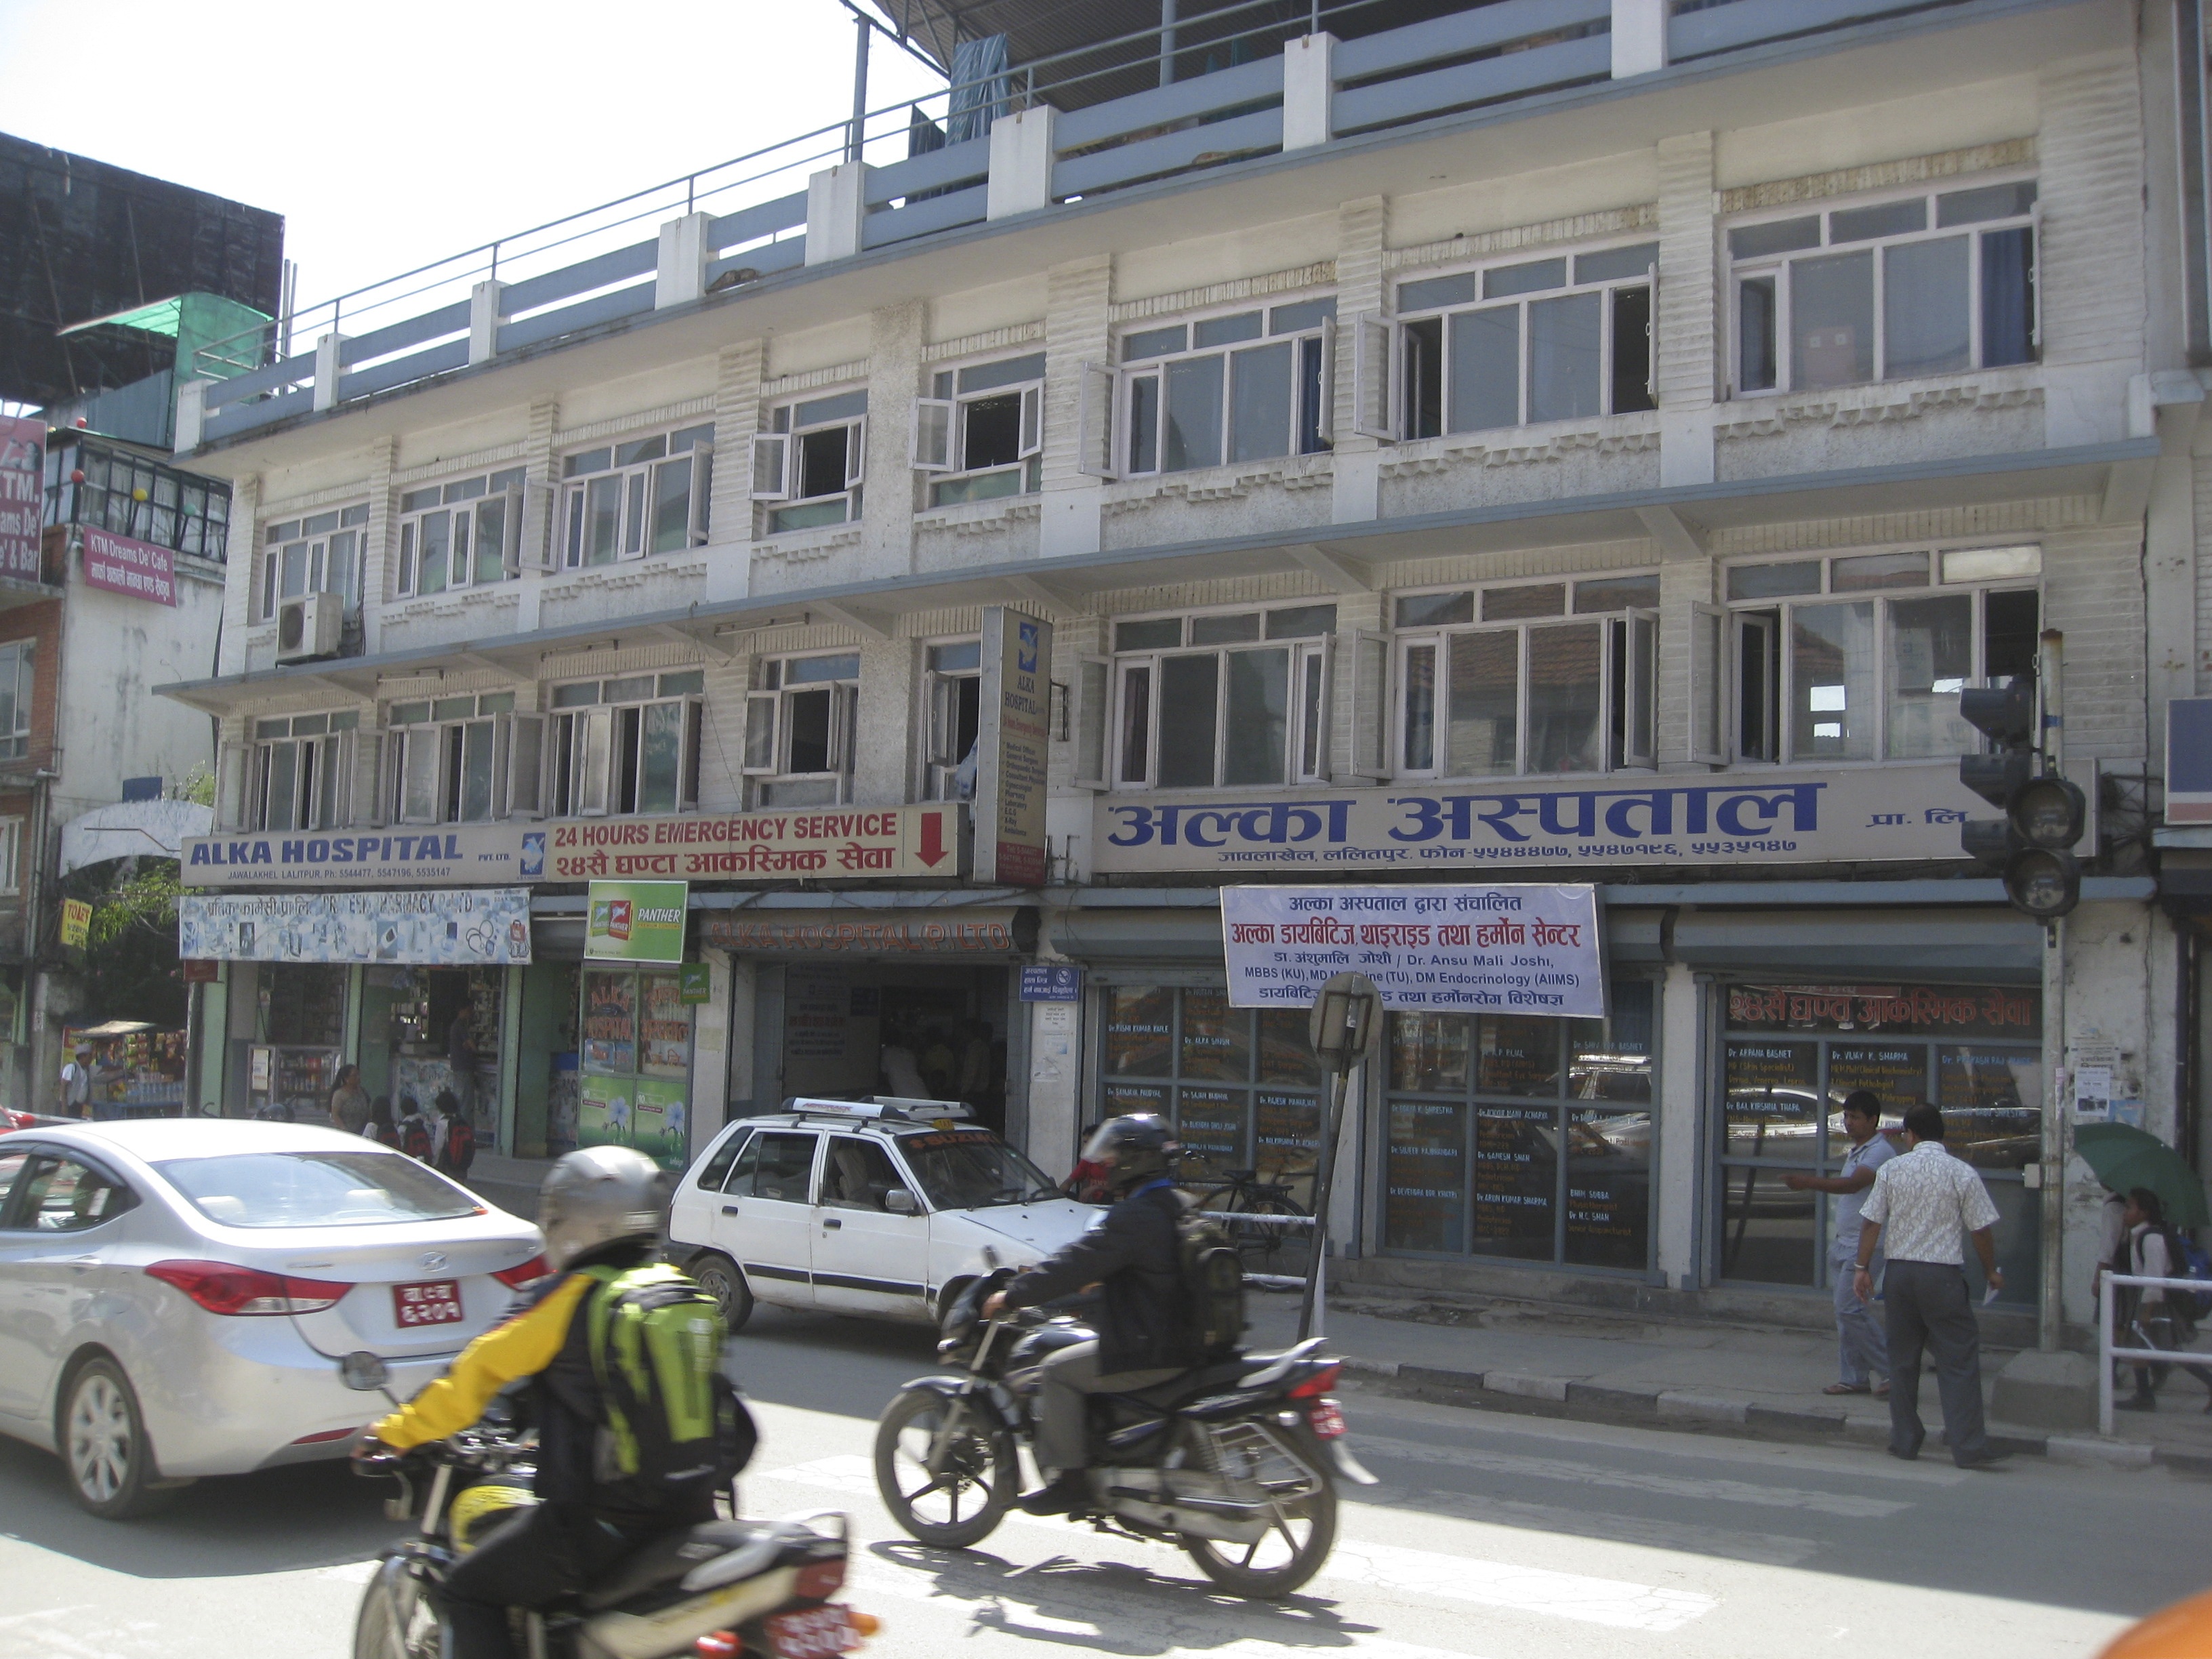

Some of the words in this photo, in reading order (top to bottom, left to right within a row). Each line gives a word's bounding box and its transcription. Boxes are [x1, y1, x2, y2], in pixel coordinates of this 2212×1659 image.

[0, 470, 39, 503] TM.
[0, 511, 21, 536] ams
[91, 533, 108, 556] KTM
[110, 540, 138, 563] Dreams
[20, 541, 39, 573] Bar
[1018, 676, 1035, 694] ALKA
[1004, 691, 1036, 715] HOSPITAL
[1006, 741, 1021, 752] Medical
[1006, 751, 1022, 761] General
[1005, 790, 1025, 801] Pharmacy
[1005, 798, 1027, 811] Laboratory
[1004, 817, 1017, 827] X-Ray
[1107, 800, 1357, 848] अल्का
[1388, 782, 1828, 843] अस्पताल
[1865, 813, 1912, 828] प्रा.
[554, 829, 577, 847] 24
[583, 824, 649, 846] HOURS
[655, 817, 787, 844] EMERGENCY
[794, 813, 897, 840] SERVICE
[1004, 826, 1027, 837] Ambulance
[190, 838, 274, 866] ALKA
[281, 835, 464, 864] HOSPITAL
[1218, 847, 1318, 863] जावलाखेल,
[1692, 839, 1797, 854] ५५३५१४७
[556, 848, 608, 877] २४सै
[615, 854, 676, 875] घण्टा
[684, 844, 827, 873] आकस्मिक
[837, 842, 896, 870] सेवा
[325, 870, 337, 878] Ph:
[416, 867, 451, 877] 5535147
[1288, 896, 1334, 912] अल्का
[1339, 895, 1408, 912] अस्पताल
[1414, 895, 1448, 914] द्वारा
[1454, 892, 1522, 912] संचालित
[638, 907, 681, 923] PANTHER
[710, 923, 775, 949] ALKA
[779, 922, 922, 950] HOSPITAL
[1231, 922, 1275, 945] अल्का
[1437, 922, 1471, 946] तथा
[1475, 916, 1525, 947] हर्मोन
[1531, 916, 1582, 947] सेन्टर
[1273, 950, 1292, 963] डा.
[1295, 949, 1350, 966] अंशुमालि
[1357, 949, 1393, 965] जोशी
[1407, 954, 1425, 966] Dr.
[1431, 955, 1467, 966] Ansu
[1473, 954, 1504, 967] Mali
[1245, 966, 1277, 979] MBBS
[1309, 968, 1328, 981] MD
[1385, 972, 1413, 986] (TU),
[1416, 973, 1435, 983] DM
[1440, 972, 1532, 987] Endocrinology
[1534, 973, 1580, 987] (AIIMS)
[592, 986, 630, 1012] ALKA
[1398, 990, 1427, 1003] तथा
[1729, 986, 1787, 1021] २४सै
[1858, 987, 1977, 1025] आकस्मिक
[1981, 987, 2033, 1026] सेवा
[1133, 1025, 1151, 1033] KUMAR
[1619, 1042, 1643, 1051] BASNET
[1766, 1049, 1793, 1059] BASNET
[1832, 1050, 1842, 1059] Dr.
[1879, 1052, 1909, 1061] SHARMA
[1736, 1101, 1749, 1111] BAL
[1780, 1103, 1801, 1112] THAPA
[1487, 1152, 1511, 1162] GANESH
[1514, 1153, 1530, 1162] SHAH
[1523, 1196, 1548, 1207] SHARMA
[1591, 1212, 1610, 1222] SHAH
